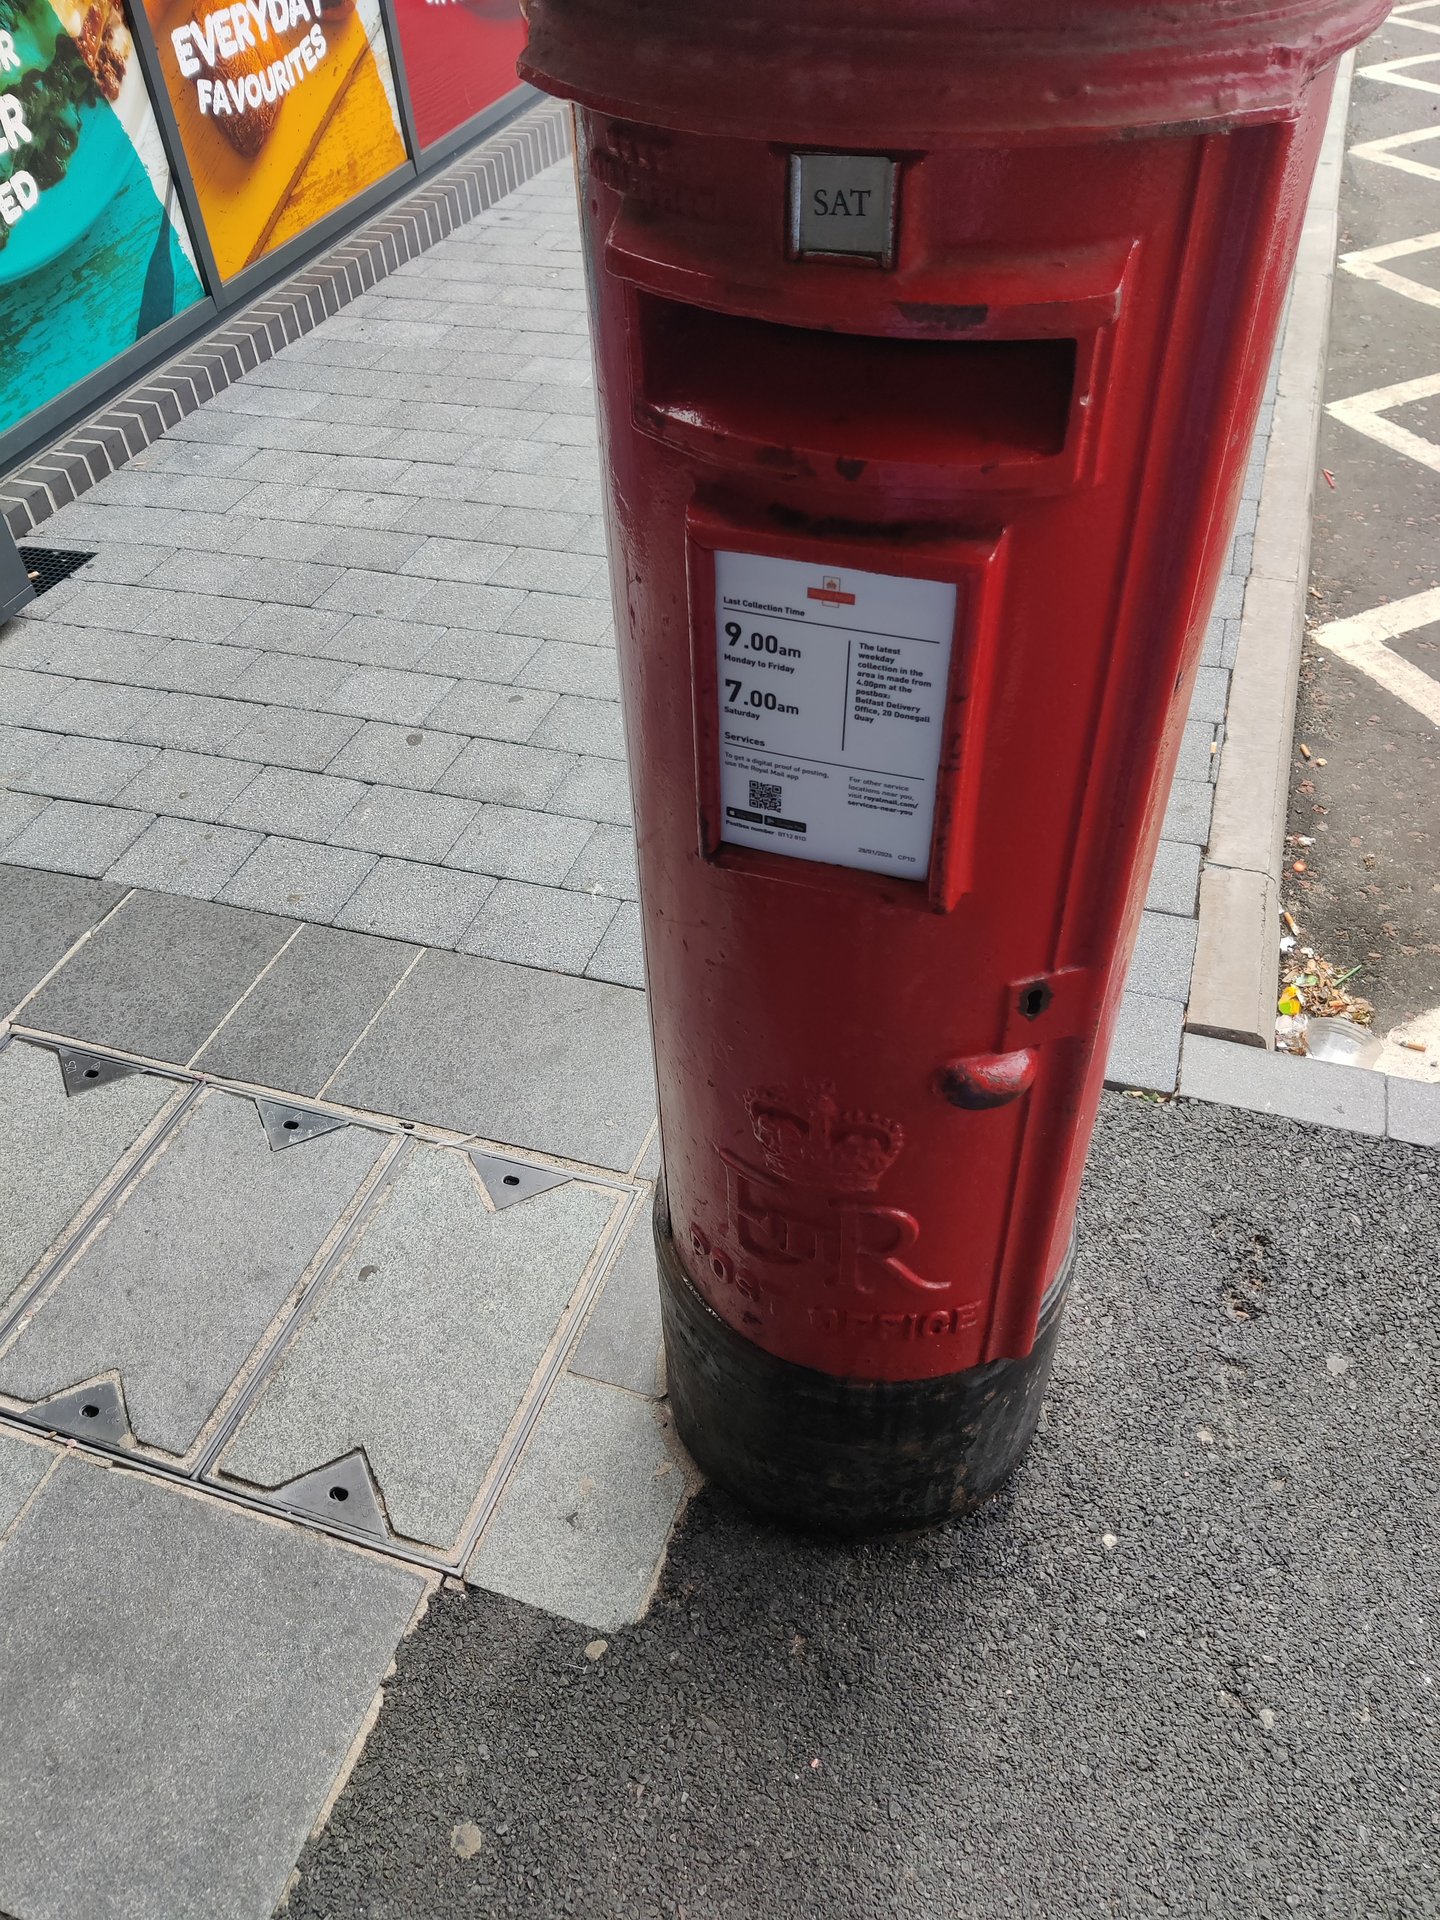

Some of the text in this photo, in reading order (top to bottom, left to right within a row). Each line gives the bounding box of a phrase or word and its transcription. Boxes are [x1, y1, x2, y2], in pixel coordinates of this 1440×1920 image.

[196, 23, 327, 115] FAVOURITES
[0, 93, 33, 152] R
[813, 189, 871, 217] SAT
[723, 596, 805, 616] Last Collection Time
[725, 622, 801, 658] 9.00am
[859, 642, 901, 655] The latest
[724, 654, 795, 674] Monday to Friday
[858, 653, 895, 664] weekday
[858, 662, 898, 672] collection
[856, 680, 886, 689] 4.00pm
[886, 676, 910, 684] made
[912, 678, 932, 687] from
[725, 678, 799, 715] 7.00am
[854, 706, 880, 716] Office,
[856, 696, 920, 714] Belfast Delivery
[724, 706, 760, 720] Saturday
[854, 714, 874, 724] Quay
[724, 732, 766, 746] Services
[750, 765, 769, 774] Royal
